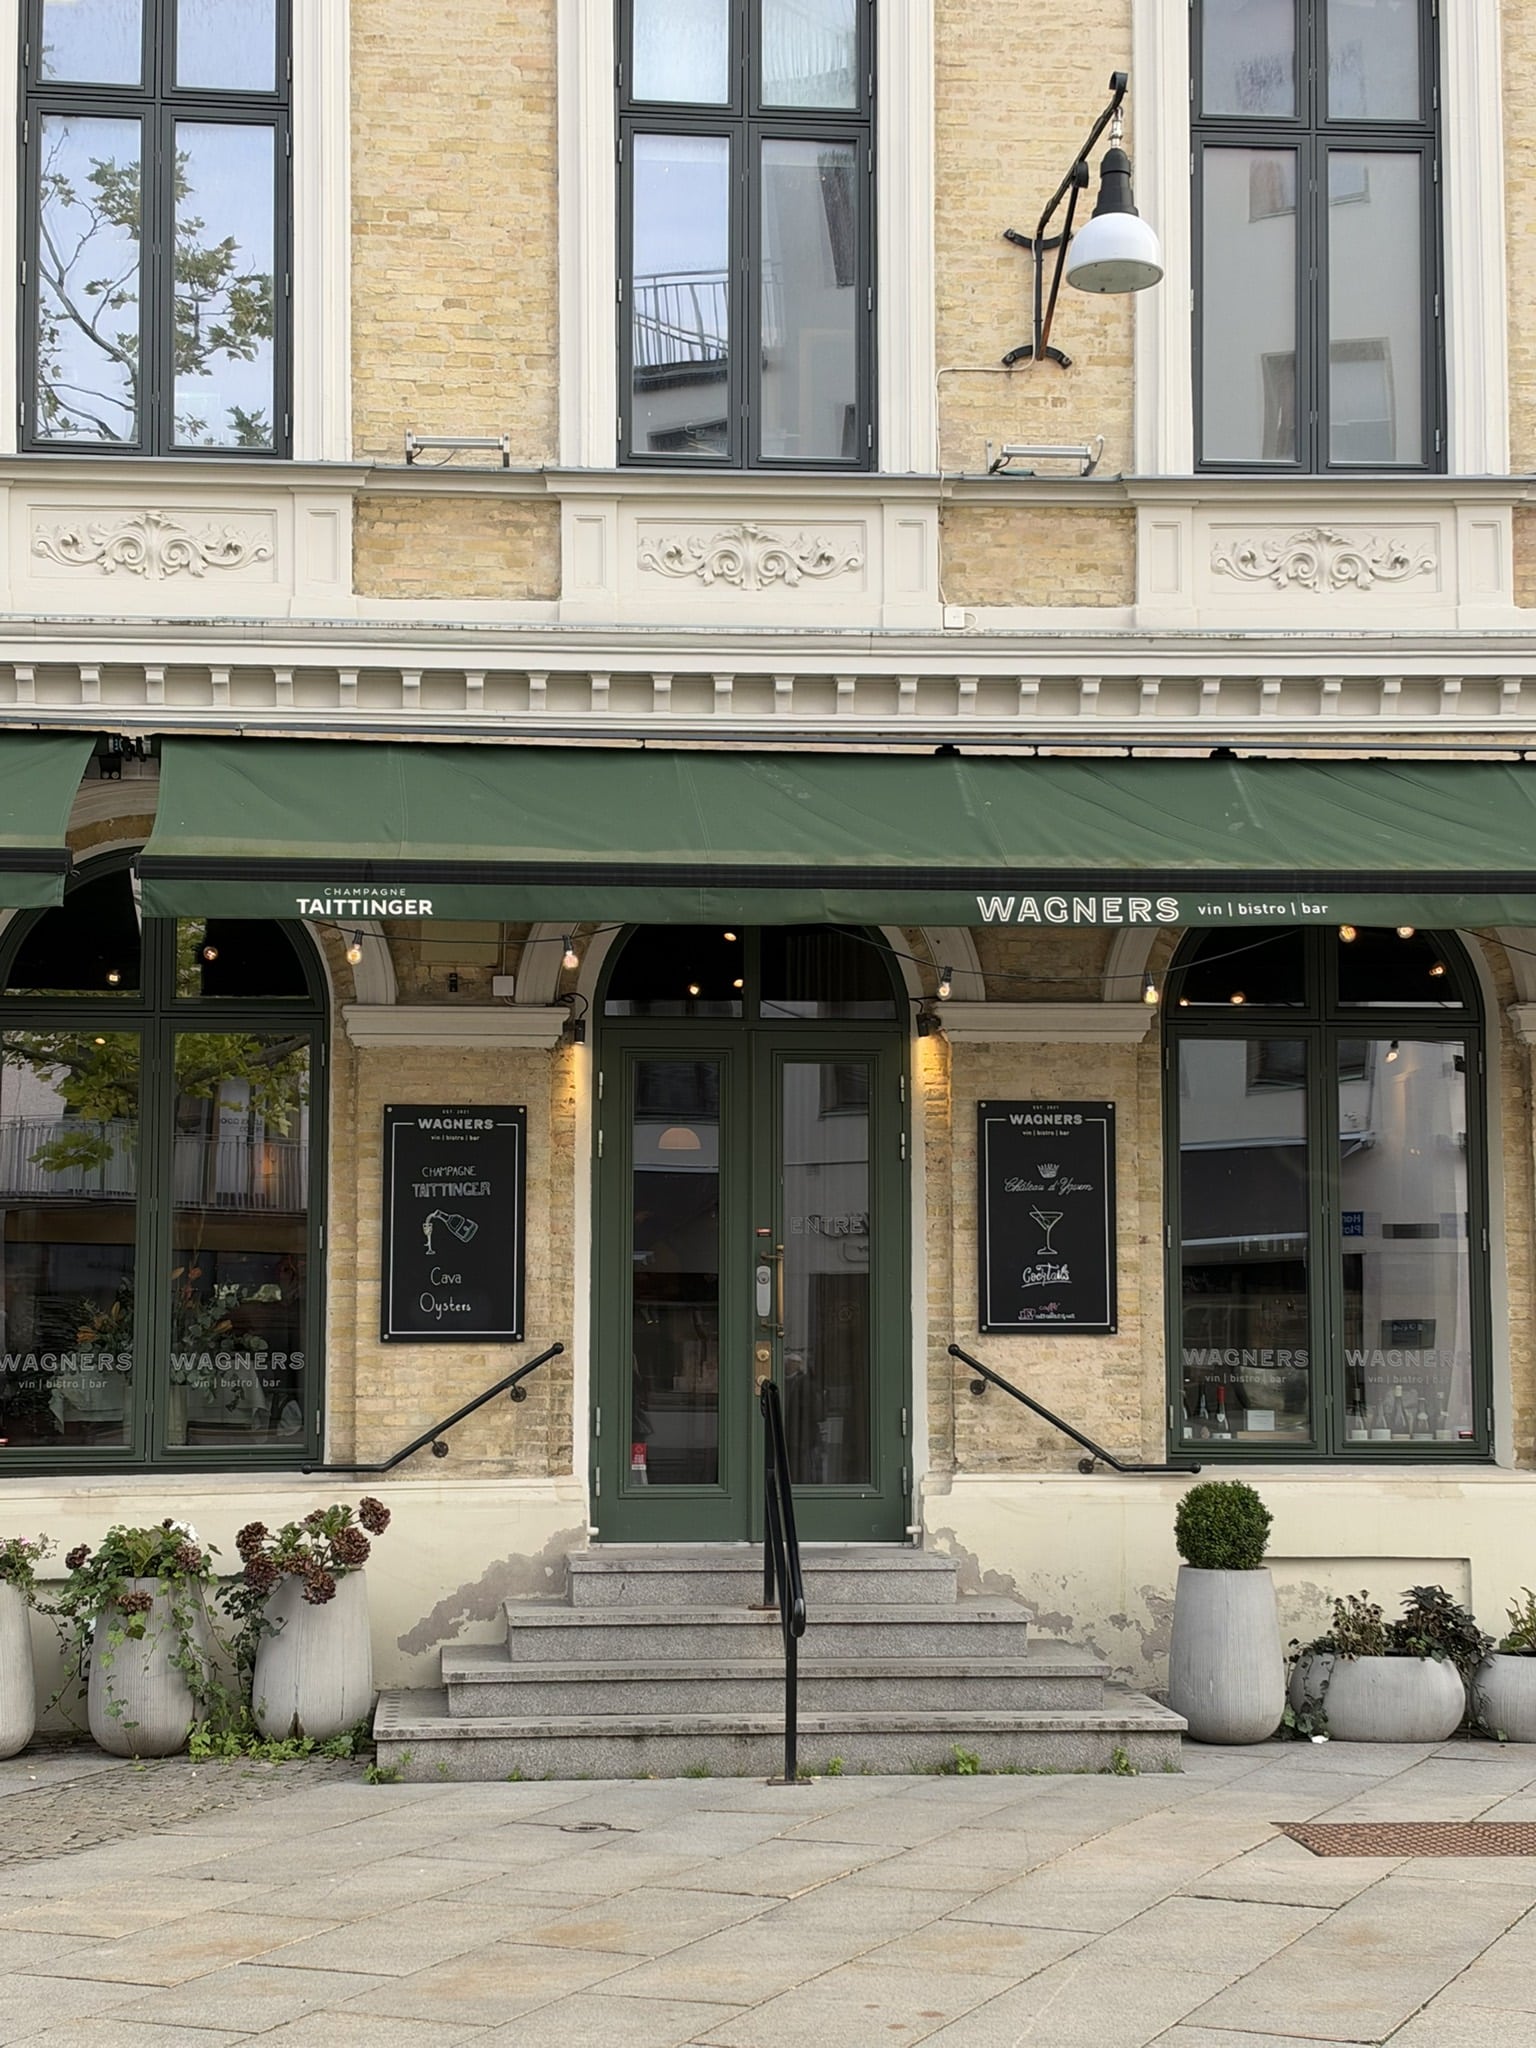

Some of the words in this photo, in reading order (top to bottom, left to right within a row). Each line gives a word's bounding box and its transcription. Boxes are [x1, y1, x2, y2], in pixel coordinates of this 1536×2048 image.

[324, 887, 406, 896] CHAMPAGNE
[296, 898, 433, 915] TAITTINGER
[976, 896, 1180, 923] WAGNERS
[1197, 903, 1223, 915] vin
[1238, 902, 1286, 915] bistro
[1301, 902, 1329, 915] bar
[418, 1118, 494, 1130] WAGNERS
[1009, 1114, 1083, 1125] WAGNERS
[421, 1165, 477, 1178] CHAMPAGNE
[412, 1181, 491, 1198] TAITTINGER
[430, 1266, 462, 1286] Cava
[420, 1292, 472, 1320] Oysters
[0, 1353, 132, 1371] WAGNERS
[170, 1352, 305, 1371] WAGNERS
[1182, 1348, 1309, 1367] WAGNERS
[19, 1380, 35, 1389] vin
[46, 1379, 79, 1389] bistro
[89, 1379, 108, 1389] bar
[193, 1378, 210, 1387] vin
[220, 1377, 252, 1388] bistro
[262, 1378, 281, 1387] bar
[1205, 1374, 1222, 1382] vin
[1230, 1374, 1261, 1383] bistro
[1270, 1375, 1287, 1383] bar
[1367, 1375, 1384, 1383] vin
[1393, 1374, 1424, 1383] bistro
